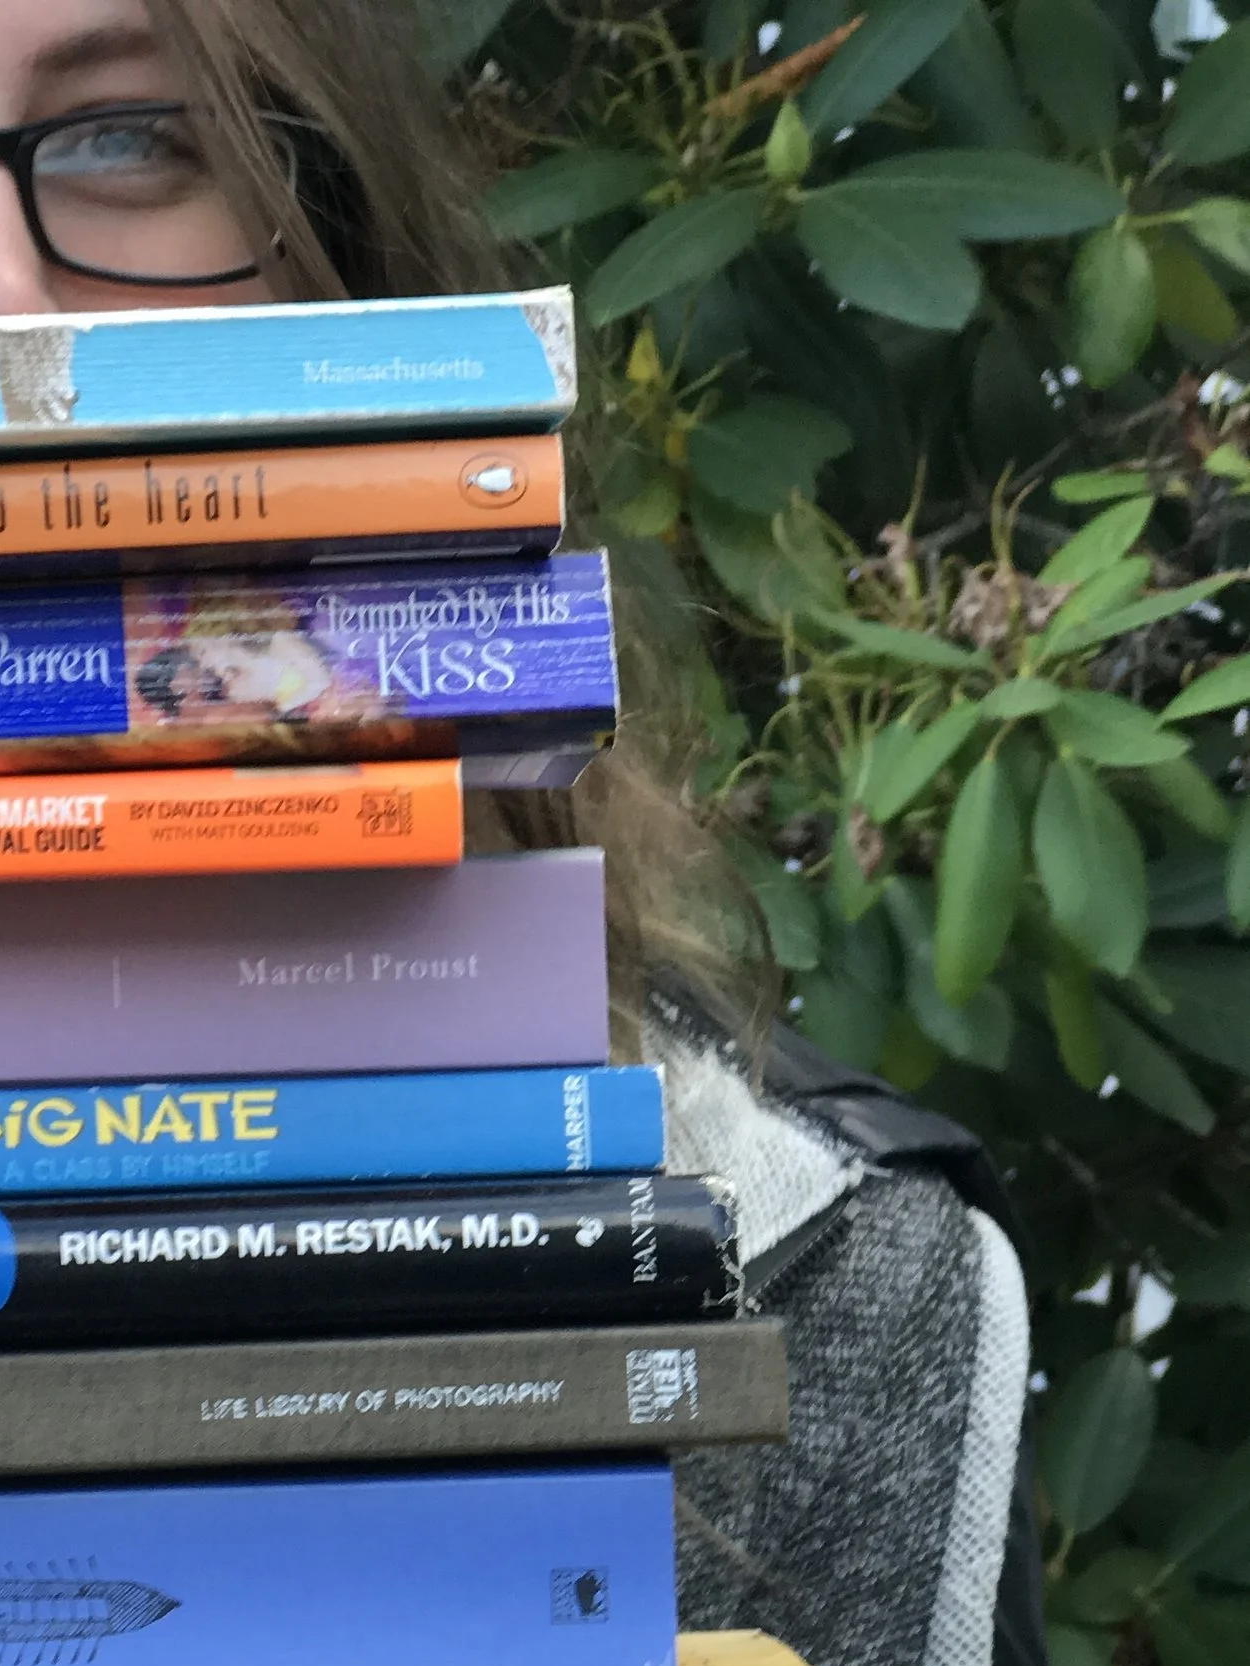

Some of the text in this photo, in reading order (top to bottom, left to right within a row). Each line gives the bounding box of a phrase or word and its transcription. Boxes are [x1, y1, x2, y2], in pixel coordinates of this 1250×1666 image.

[303, 356, 484, 384] Massachusetts
[42, 462, 111, 531] the
[145, 459, 269, 526] heart
[316, 583, 571, 643] Tempted By His
[130, 796, 339, 820] BY DAVID ZINCZENKO
[35, 825, 106, 854] GUIDE
[150, 823, 193, 842] WITH
[198, 822, 236, 839] MATT
[237, 951, 478, 987] Marcel Proust
[95, 1089, 278, 1146] NATE
[563, 1075, 585, 1171] HARPER
[5, 1158, 25, 1183] A
[33, 1155, 111, 1182] CLASS
[121, 1154, 152, 1179] BY
[162, 1150, 272, 1178] HIMSELF
[60, 1213, 549, 1266] RICHARD M. RESTAK, M.D.
[627, 1176, 658, 1283] BANTAM
[201, 1379, 565, 1422] LIFE LIBRARY OF PHOTOGRAPHY
